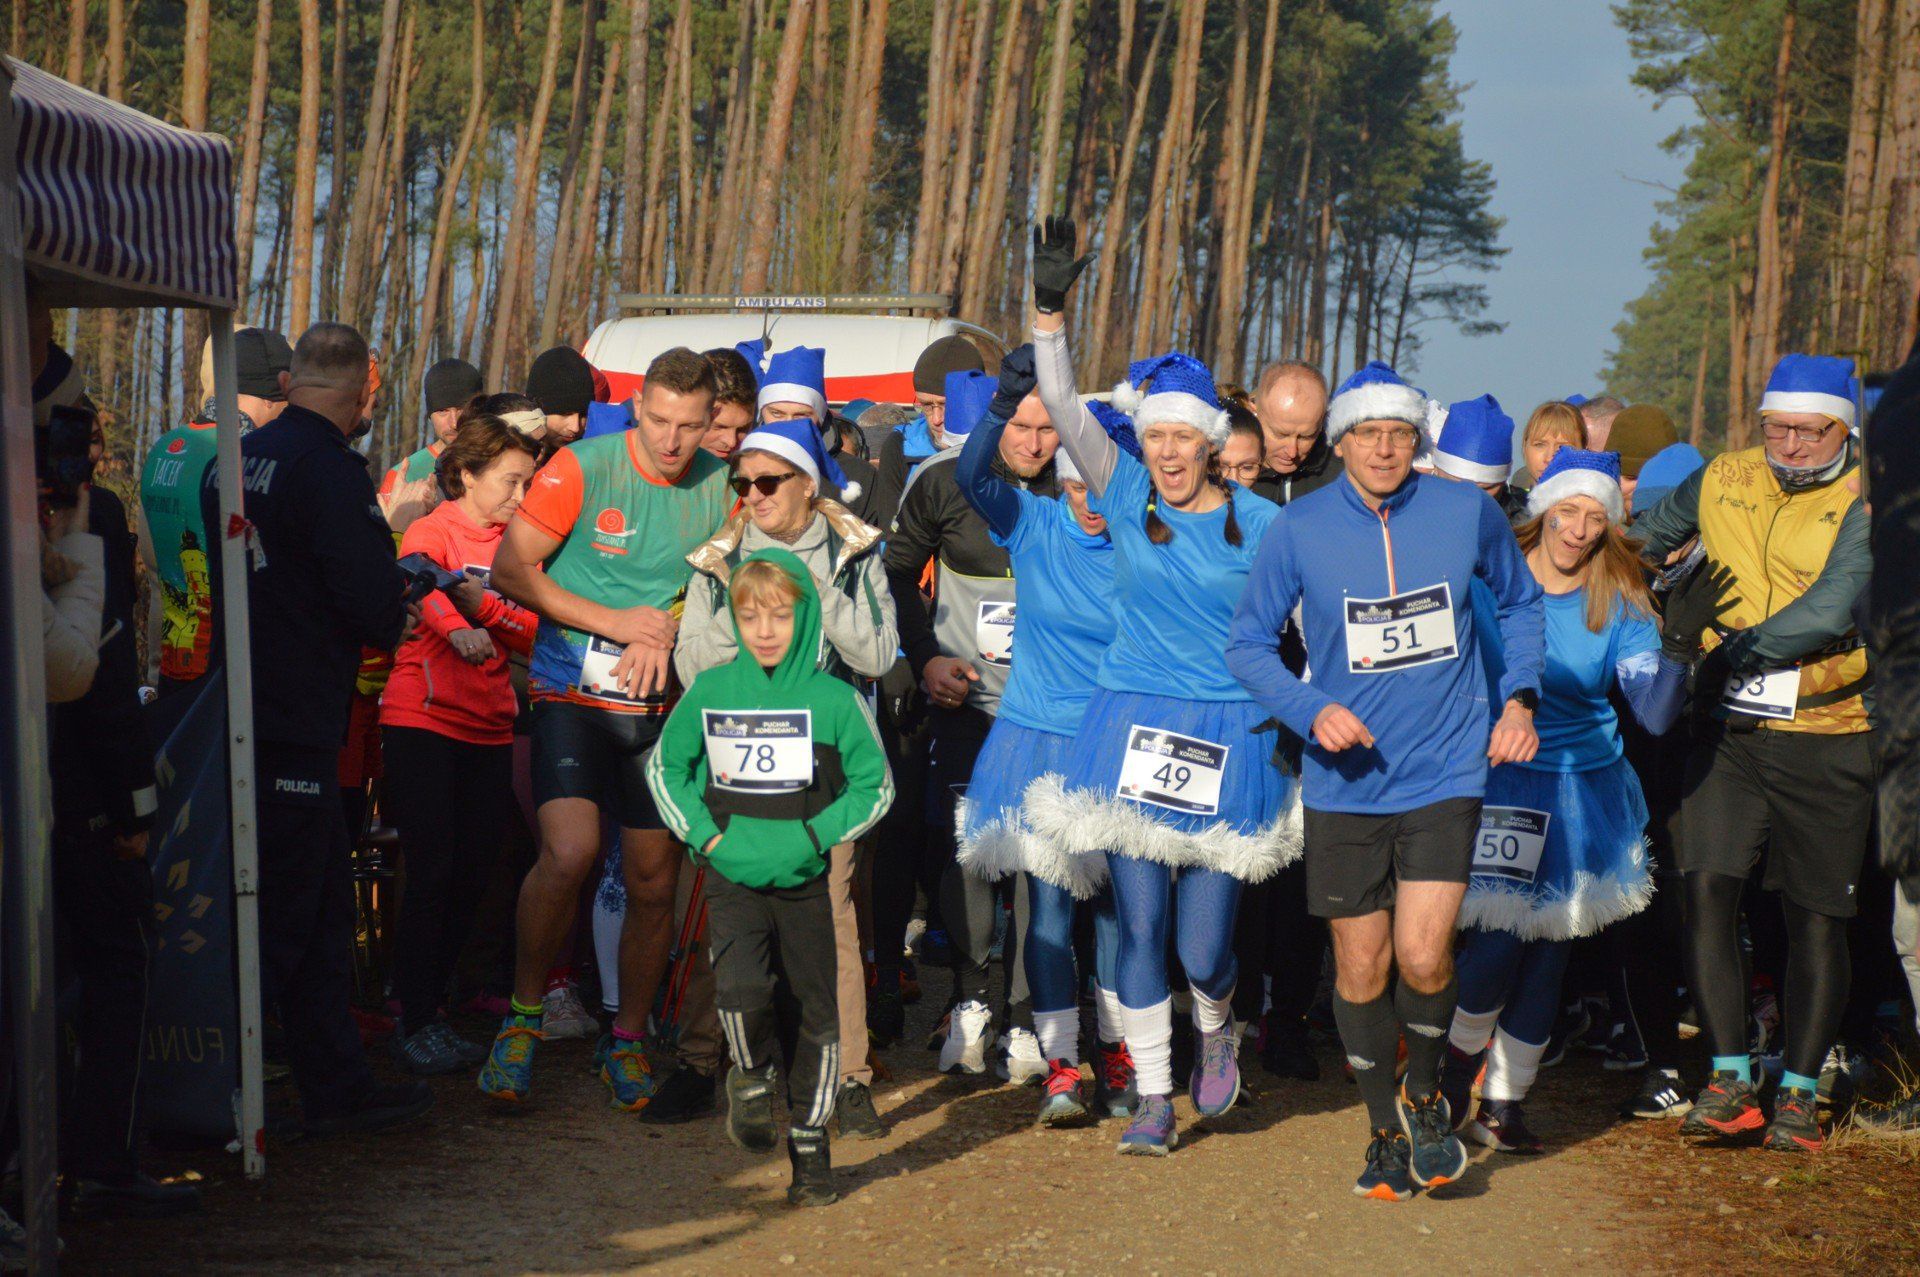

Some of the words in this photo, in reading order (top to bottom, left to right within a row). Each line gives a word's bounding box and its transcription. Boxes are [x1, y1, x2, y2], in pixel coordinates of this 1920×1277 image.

[738, 297, 825, 307] AMBULANS
[150, 458, 184, 487] JACEK
[1399, 601, 1440, 616] KOMENDANTA
[1406, 597, 1432, 608] PUCHAR
[1362, 614, 1387, 622] POLICJA
[1382, 622, 1422, 654] 51
[754, 726, 799, 735] KOMENDANTA
[763, 720, 790, 728] PUCHAR
[1180, 750, 1216, 765] KOMENDANTA
[1187, 746, 1210, 757] PUCHAR
[735, 744, 776, 773] 78
[1153, 762, 1192, 792] 49
[276, 778, 320, 795] POLICJA
[1501, 820, 1539, 831] KOMENDANTA
[1509, 815, 1533, 824] PUCHAR
[1480, 833, 1520, 861] 50
